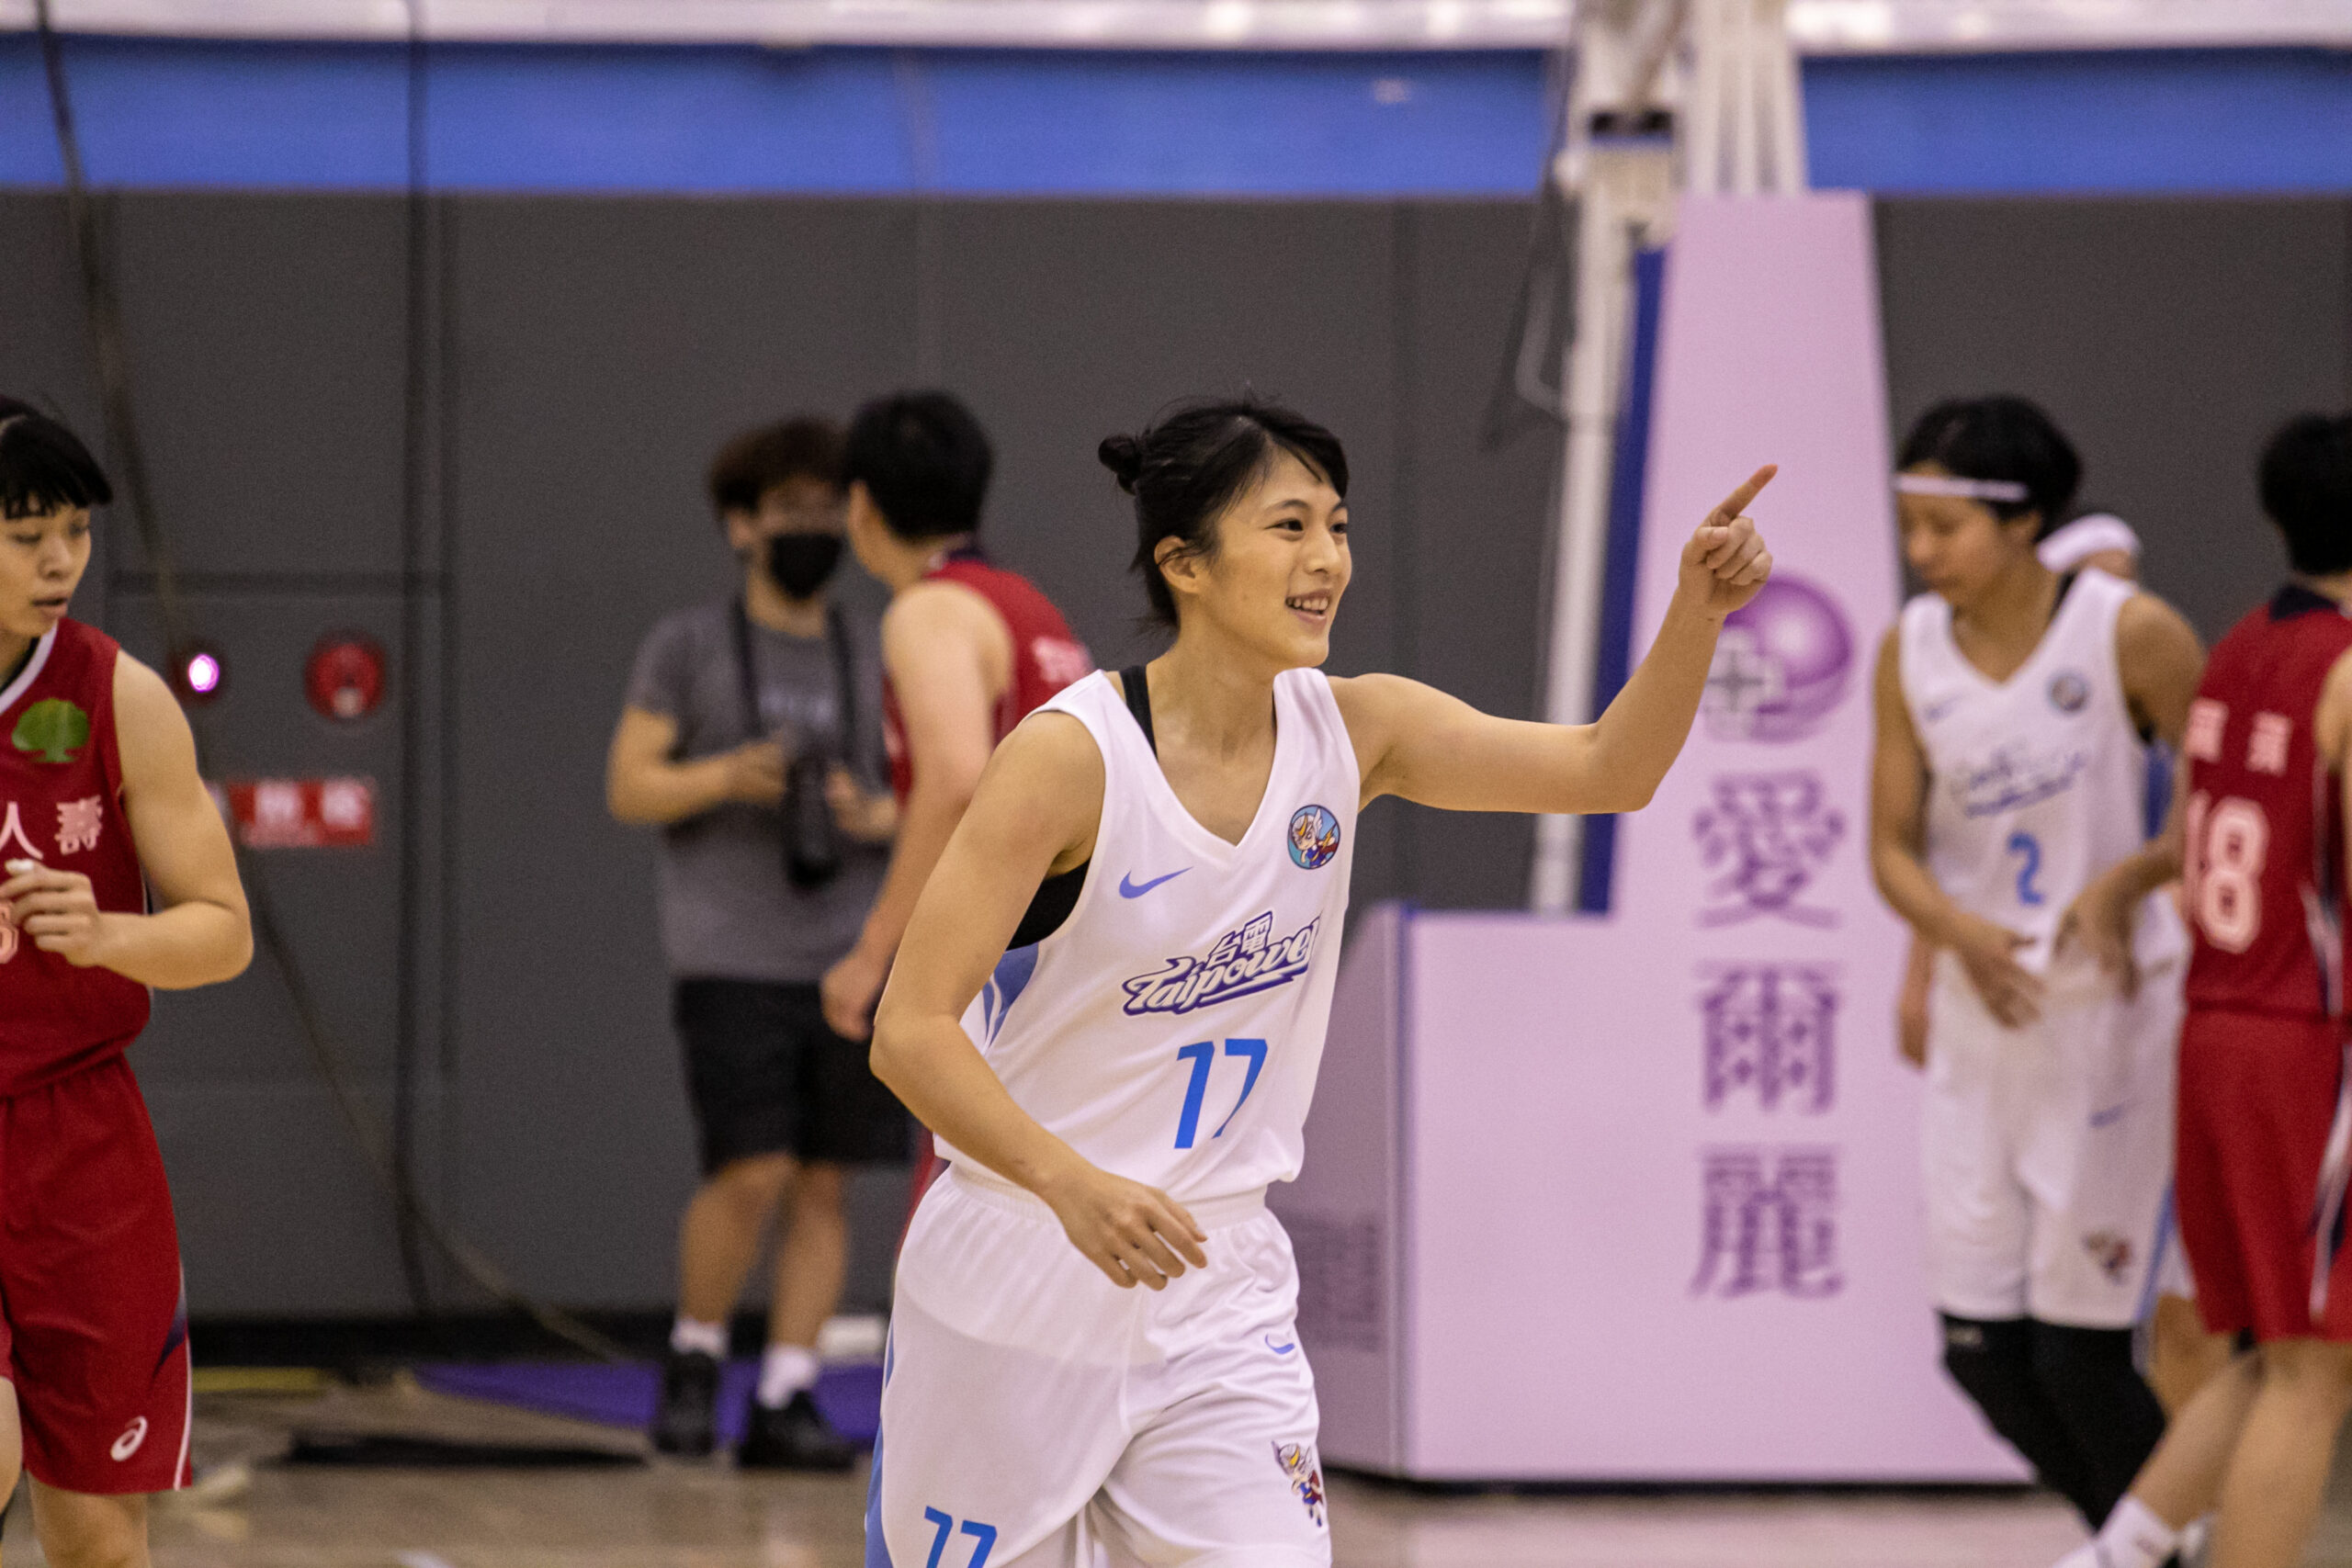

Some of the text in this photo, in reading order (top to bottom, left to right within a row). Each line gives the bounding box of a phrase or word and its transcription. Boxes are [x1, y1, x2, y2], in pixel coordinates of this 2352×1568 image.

[0, 795, 103, 860] 人壽
[2007, 830, 2045, 906] 2
[2183, 790, 2269, 953] 18
[1122, 916, 1320, 1015] Taipowe
[1205, 910, 1273, 970] 台電
[1693, 772, 1844, 1297] 愛爾麗
[1174, 1038, 1268, 1149] 17
